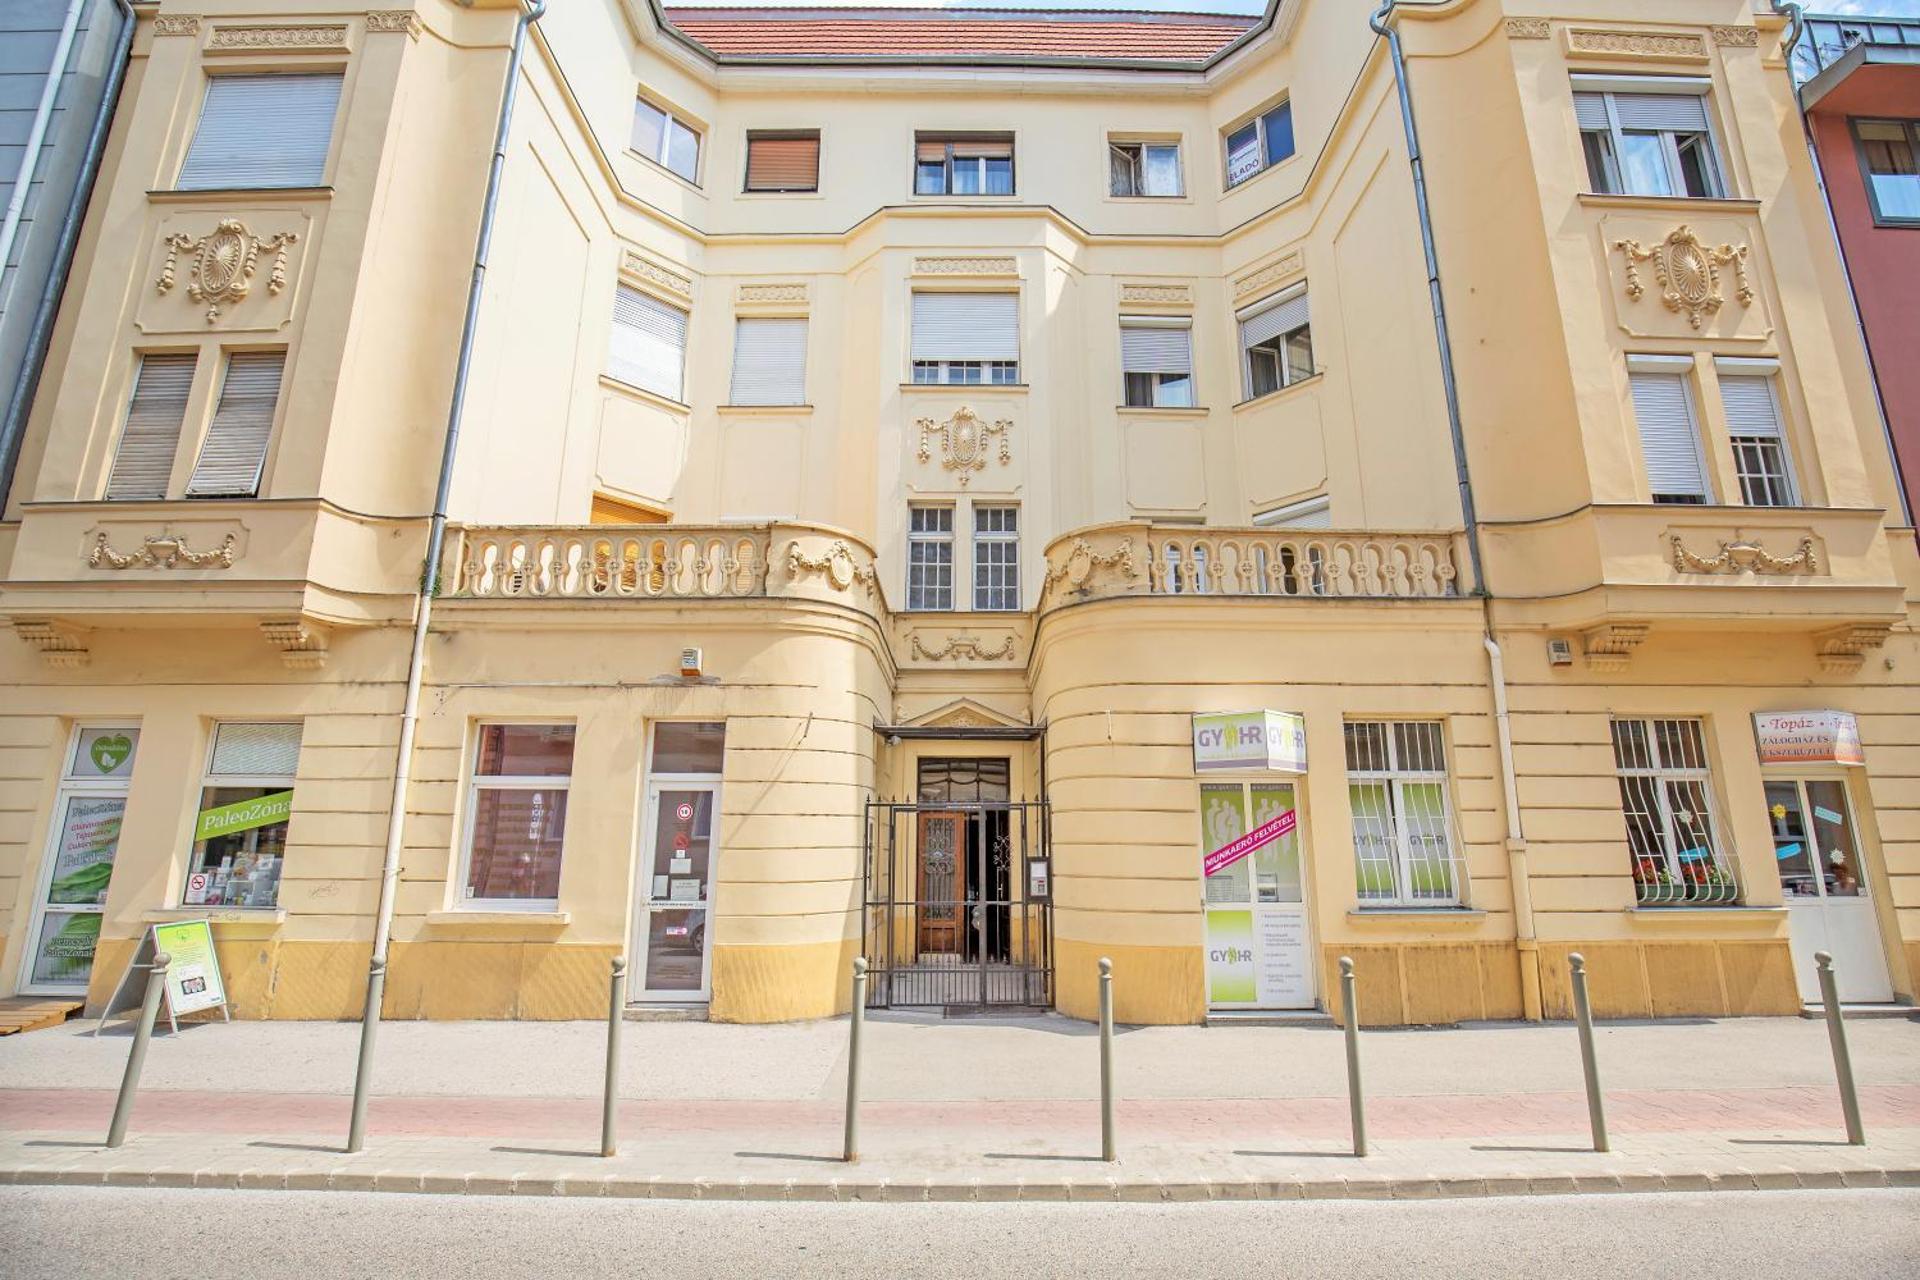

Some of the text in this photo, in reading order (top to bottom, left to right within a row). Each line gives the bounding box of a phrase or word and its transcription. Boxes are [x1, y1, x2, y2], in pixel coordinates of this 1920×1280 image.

[1769, 715, 1814, 732] Topáz
[204, 799, 292, 831] PaleoZóna
[1205, 812, 1295, 866] MUNKAERŐ FELVÉTEL!
